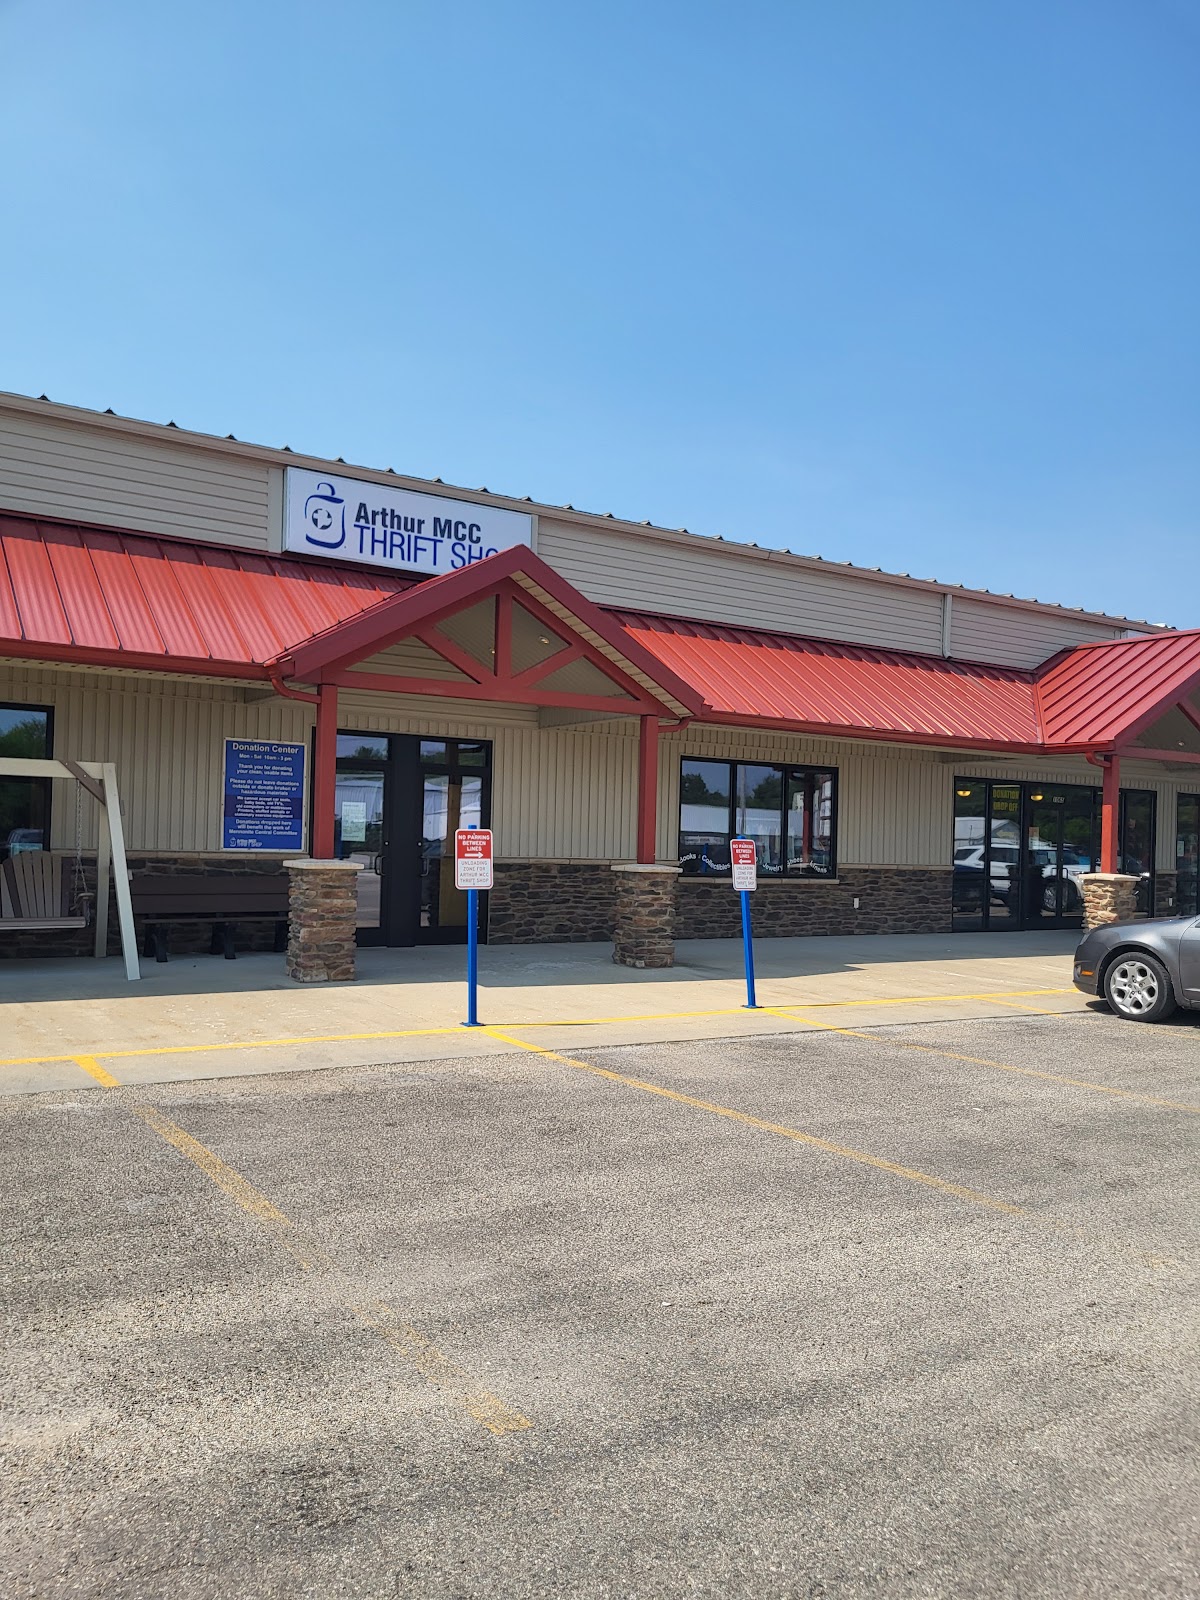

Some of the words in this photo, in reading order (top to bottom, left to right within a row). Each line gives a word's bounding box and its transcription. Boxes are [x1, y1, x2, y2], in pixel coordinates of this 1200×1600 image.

[355, 502, 425, 534] Arthur
[433, 517, 482, 544] MCC
[354, 524, 444, 566] THRIFT
[233, 742, 269, 752] Donation
[272, 745, 299, 754] Center
[992, 790, 1020, 799] DONATION
[993, 802, 1008, 810] DROP
[1009, 802, 1018, 812] OFF
[680, 852, 696, 864] Books
[702, 855, 730, 870] Collectibles
[762, 862, 783, 872] Jewelry
[787, 856, 803, 866] Shoes
